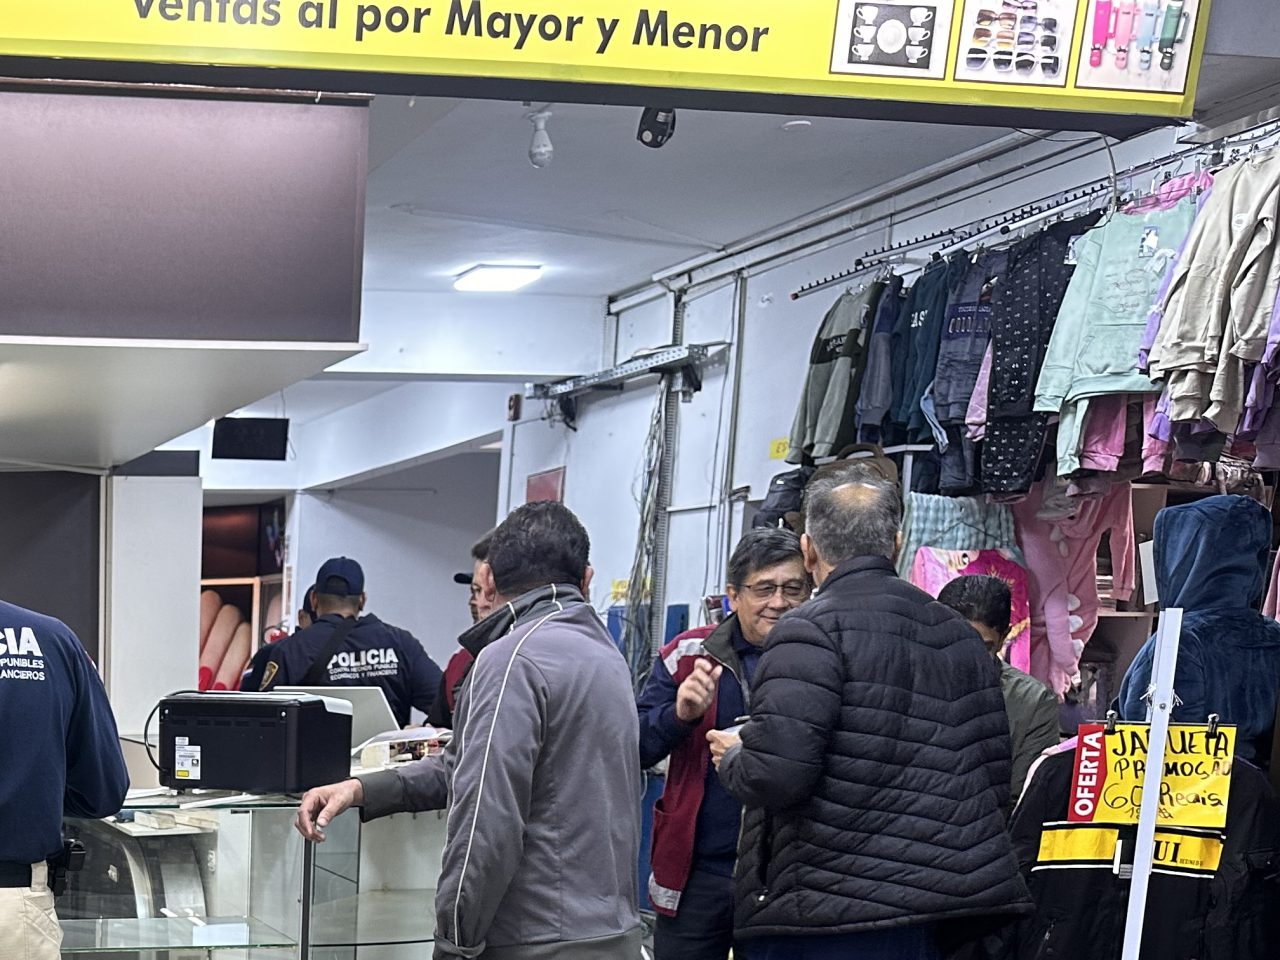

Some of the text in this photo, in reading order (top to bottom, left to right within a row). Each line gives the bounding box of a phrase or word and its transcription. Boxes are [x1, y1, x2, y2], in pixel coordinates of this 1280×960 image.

[298, 0, 338, 29] al
[355, 4, 432, 42] por
[444, 0, 584, 50] Mayor
[595, 17, 620, 55] y
[632, 8, 770, 52] Menor
[0, 657, 45, 669] PUNIBLES
[1112, 729, 1229, 757] JAUETA
[1074, 731, 1103, 817] OFERTA
[1114, 756, 1232, 780] PRMOÇÃO
